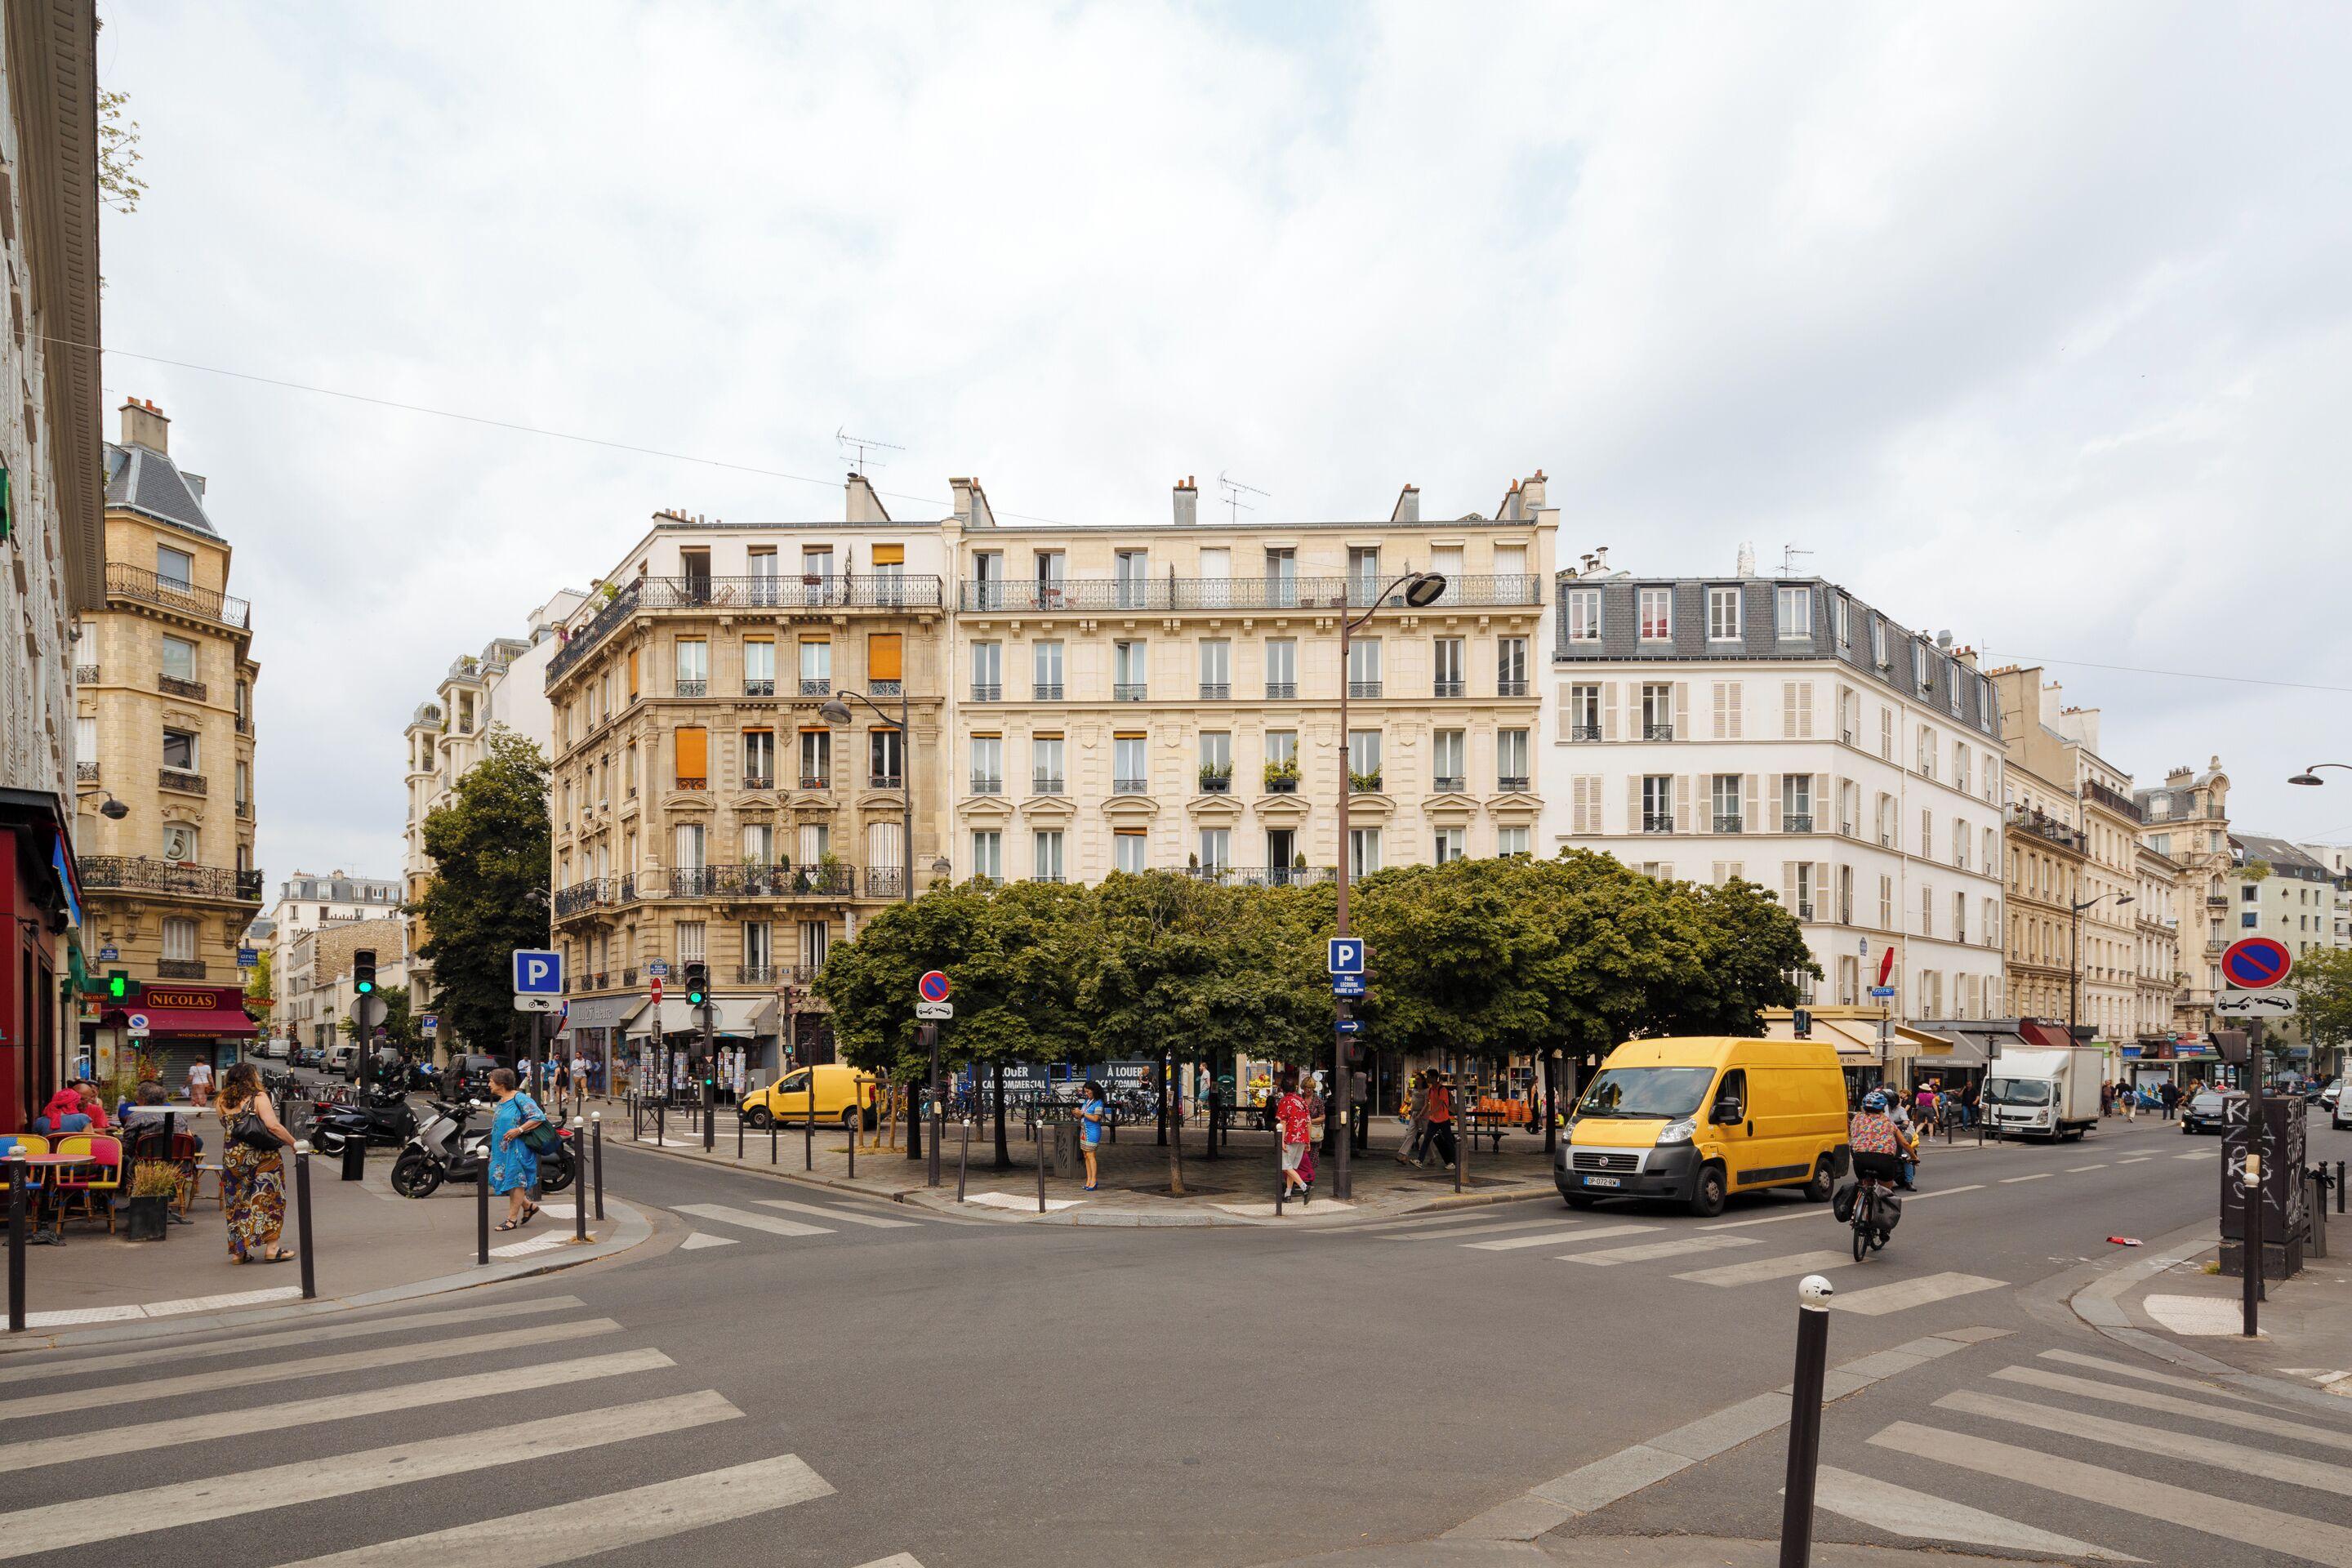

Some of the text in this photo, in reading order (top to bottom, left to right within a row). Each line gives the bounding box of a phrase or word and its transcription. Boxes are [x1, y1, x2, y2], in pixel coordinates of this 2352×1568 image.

[1339, 945, 1354, 967] P
[528, 960, 549, 986] P
[153, 994, 212, 1006] NICOLAS
[595, 1005, 612, 1020] Heure
[1107, 1065, 1114, 1077] À
[1003, 1080, 1046, 1089] OMMERCIAL
[1588, 1178, 1616, 1186] DP-072-RW
